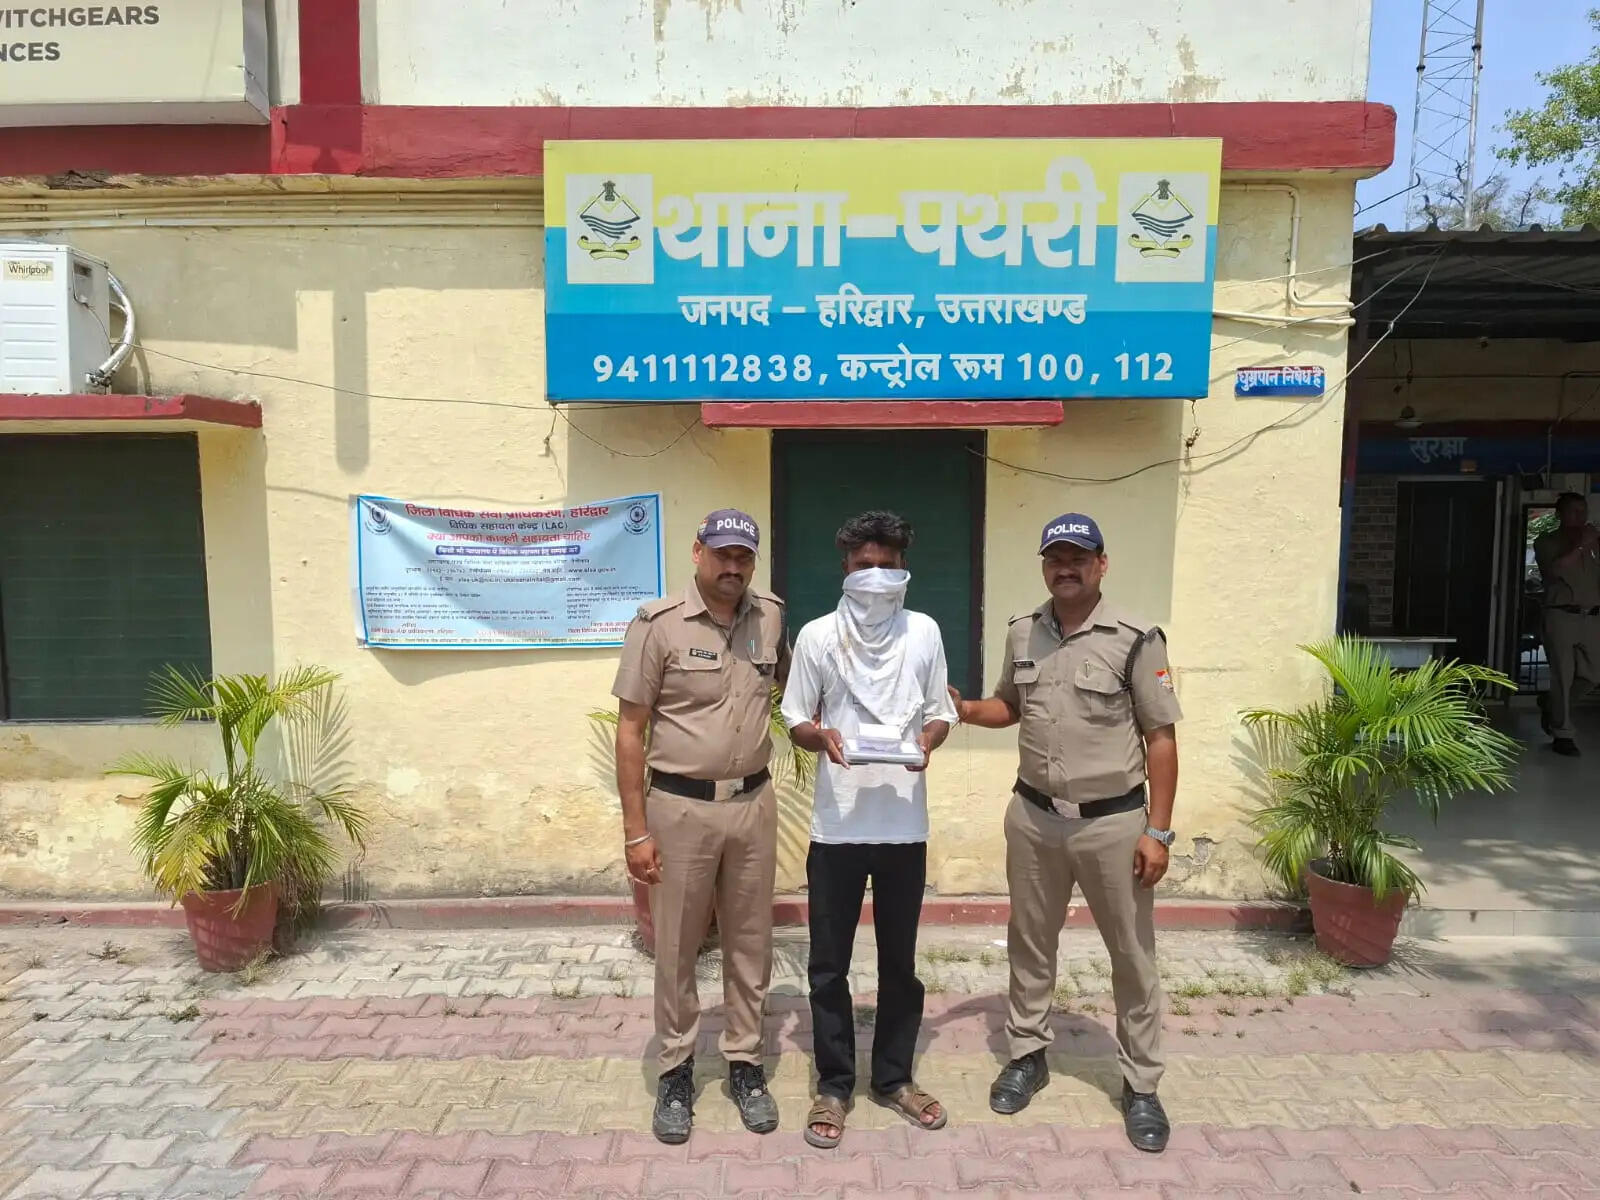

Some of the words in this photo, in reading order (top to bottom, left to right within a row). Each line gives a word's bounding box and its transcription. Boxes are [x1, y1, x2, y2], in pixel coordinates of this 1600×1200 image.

[0, 6, 160, 28] ITCHGEARS
[657, 155, 1107, 268] थाना-पथरी
[9, 265, 49, 275] Whirlpool
[677, 295, 773, 326] जनपद
[815, 282, 925, 328] हरिद्वार,
[935, 293, 1088, 325] उत्तराखण्ड
[593, 354, 828, 385] 9411112838,
[837, 343, 941, 388] कन्ट्रोल
[949, 353, 1004, 381] रूम
[1016, 353, 1100, 385] 100,
[1114, 353, 1173, 381] 112
[1408, 437, 1468, 463] सुरक्षा
[480, 521, 515, 531] सहायता
[541, 521, 568, 530] (LAC)
[716, 518, 756, 537] POLICE
[1047, 523, 1090, 539] POLICE
[522, 533, 560, 543] सहायता
